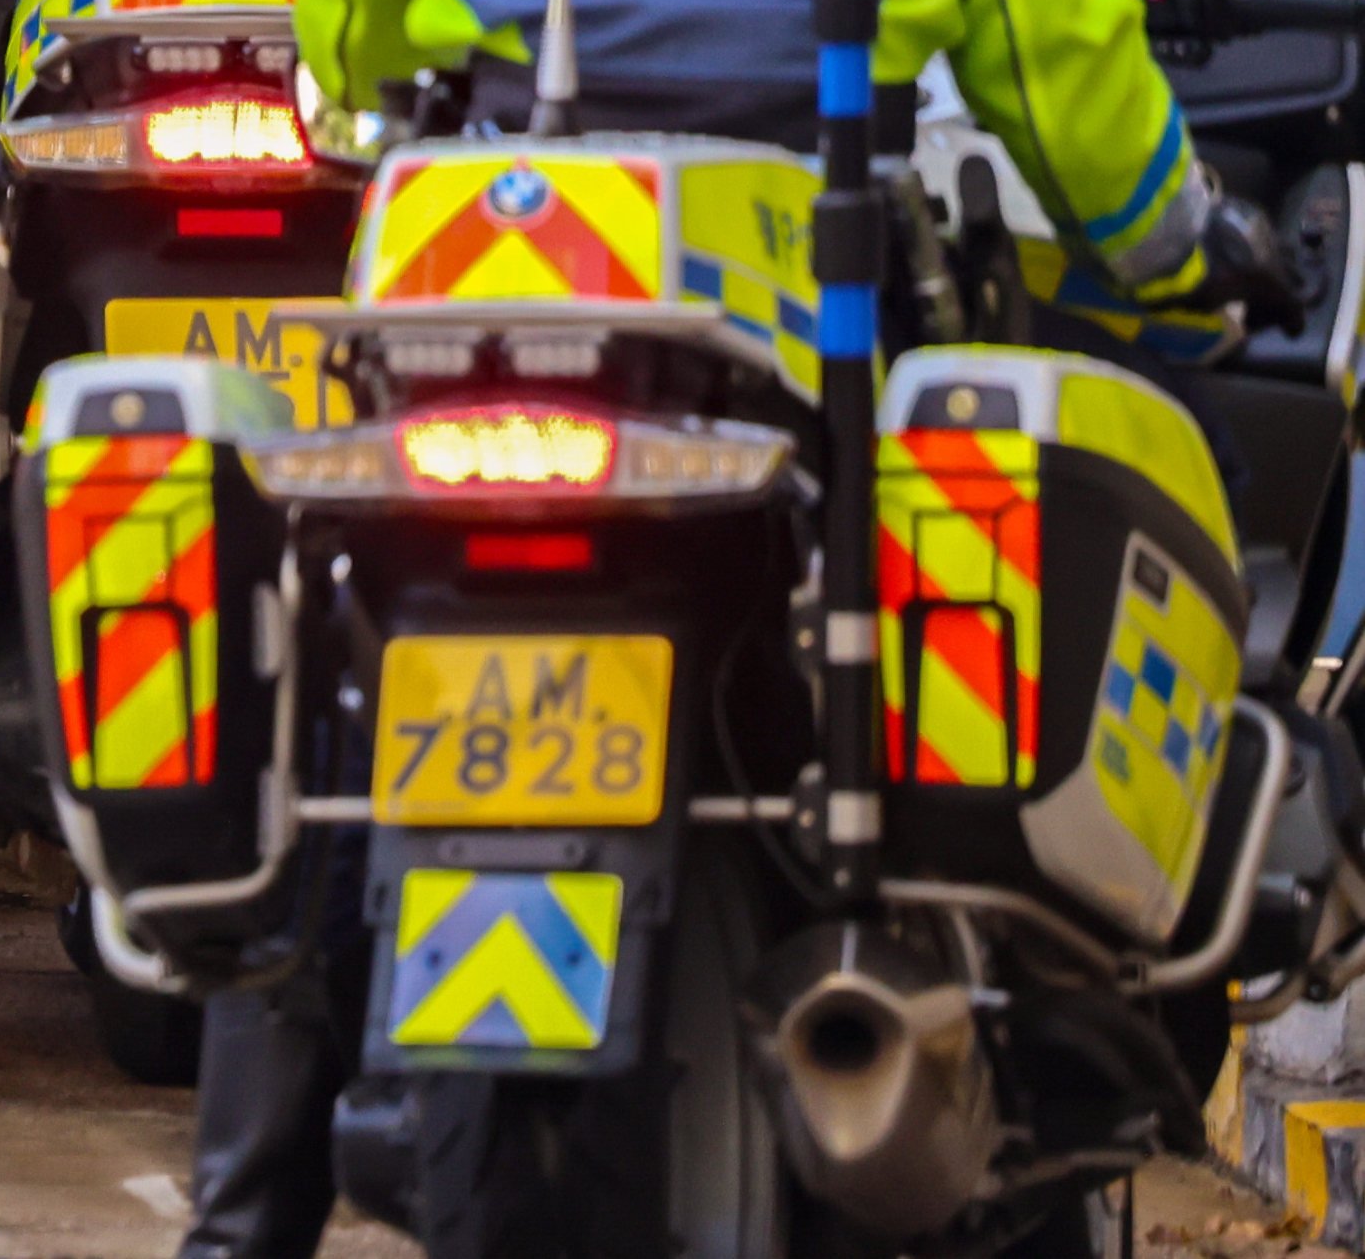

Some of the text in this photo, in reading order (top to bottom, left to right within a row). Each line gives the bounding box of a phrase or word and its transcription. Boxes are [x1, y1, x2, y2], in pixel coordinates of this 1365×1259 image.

[182, 309, 282, 371] AM
[464, 653, 588, 721] AM
[390, 720, 645, 796] 7828
